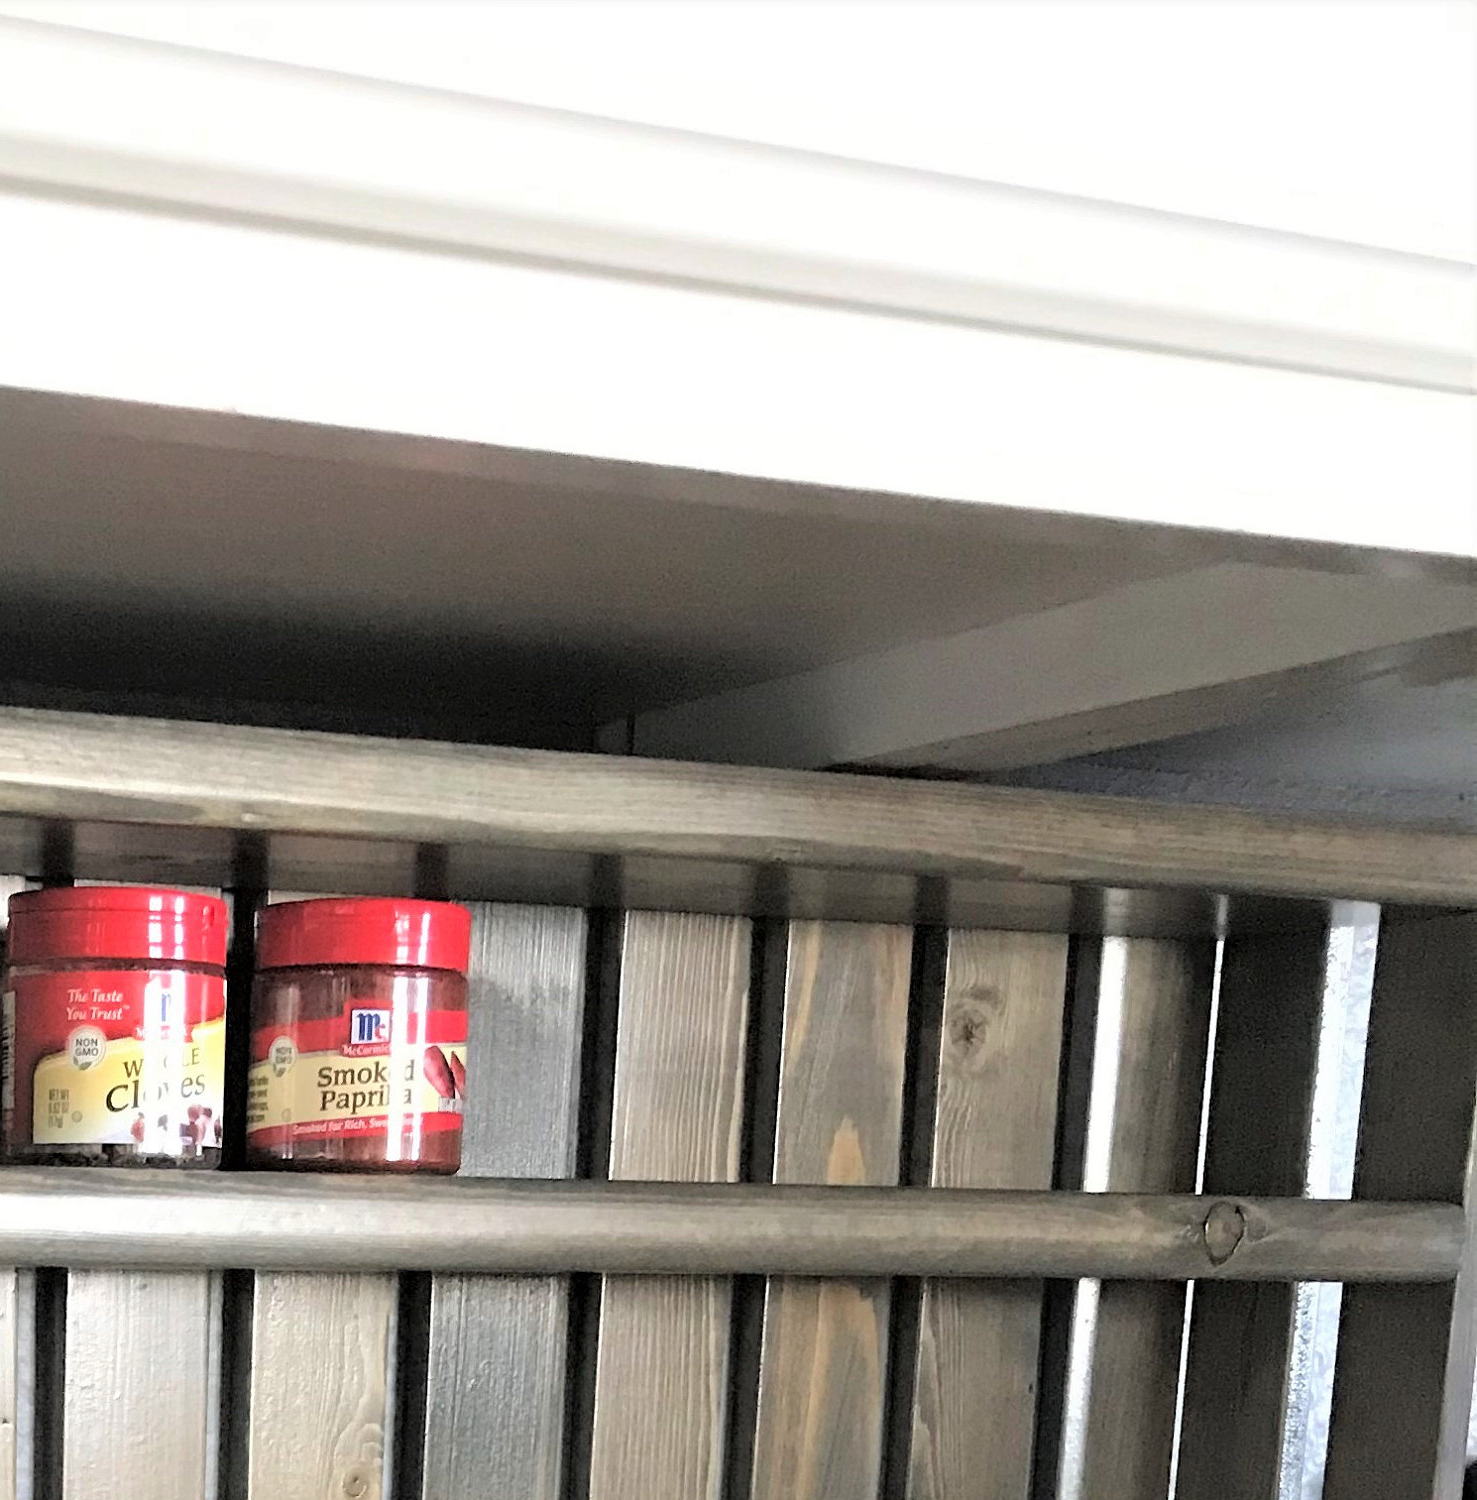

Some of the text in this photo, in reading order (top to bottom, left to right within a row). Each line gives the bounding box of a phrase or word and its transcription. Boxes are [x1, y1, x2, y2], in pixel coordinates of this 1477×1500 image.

[67, 989, 124, 1003] The Taste
[66, 1005, 86, 1021] You
[75, 1038, 98, 1047] NON
[342, 1044, 391, 1056] McCormic
[75, 1048, 99, 1057] GMO
[123, 1047, 201, 1078] WLE
[317, 1059, 415, 1088] Smokd
[319, 1084, 412, 1115] Papria
